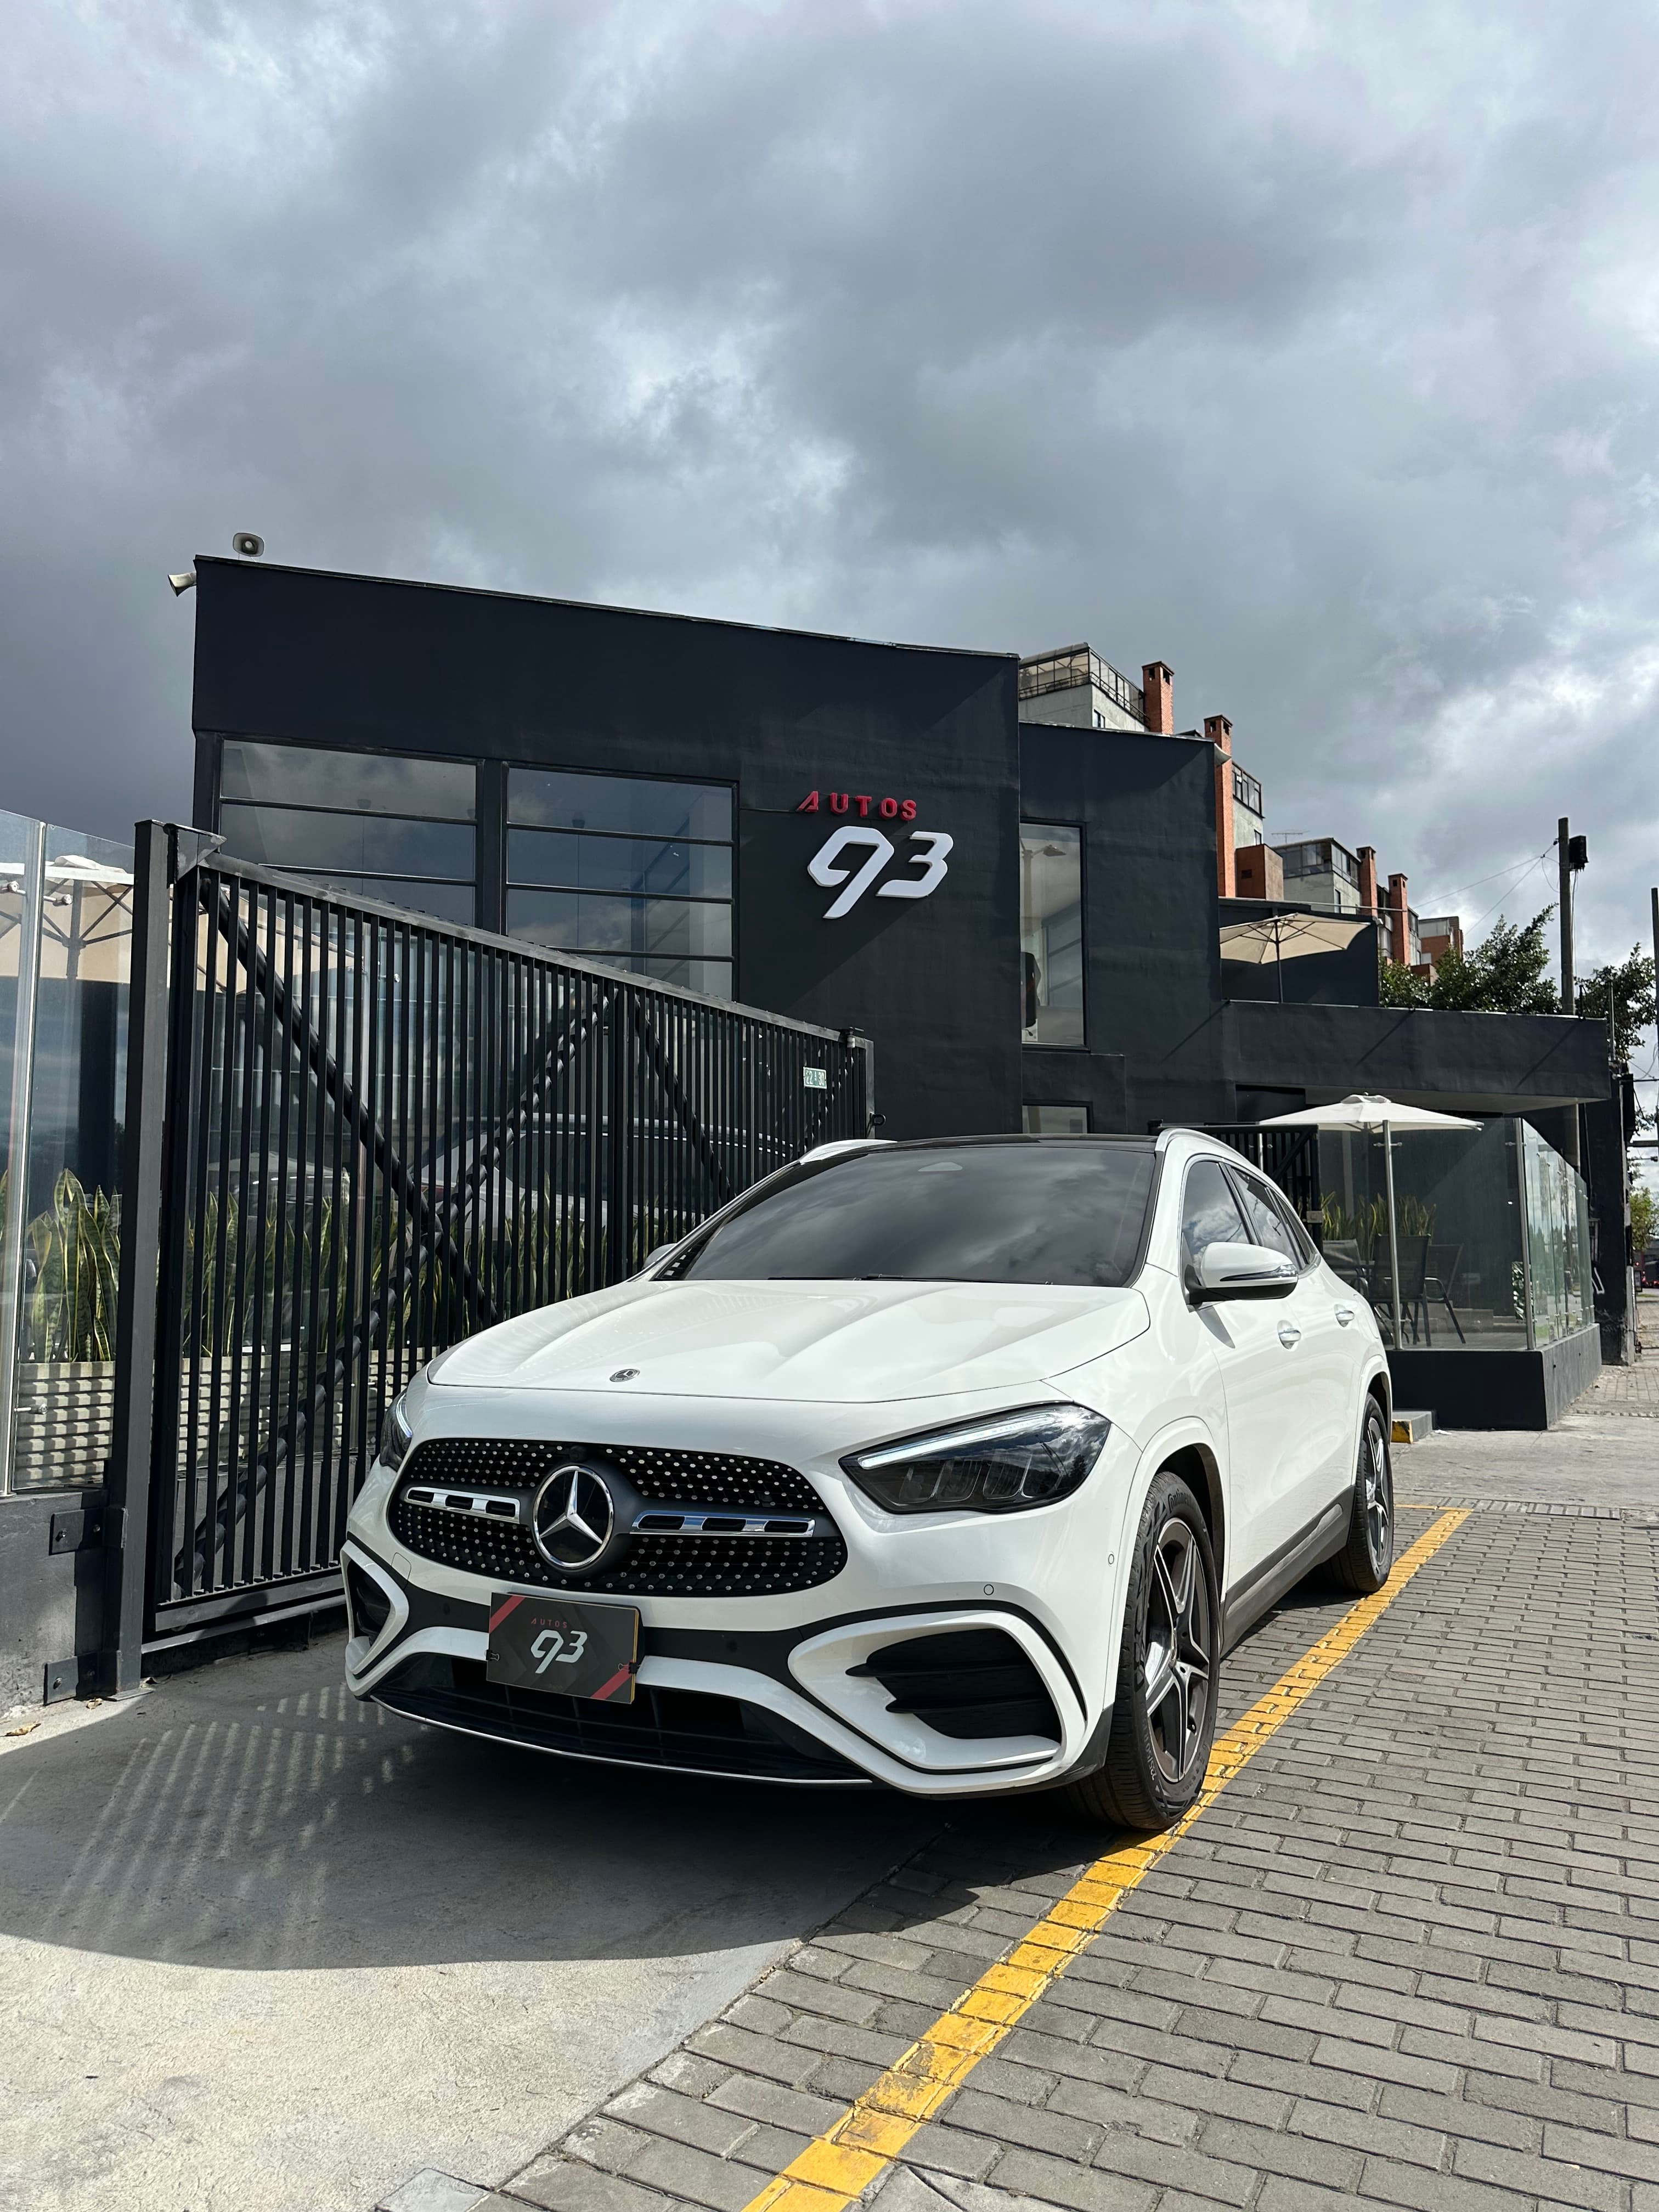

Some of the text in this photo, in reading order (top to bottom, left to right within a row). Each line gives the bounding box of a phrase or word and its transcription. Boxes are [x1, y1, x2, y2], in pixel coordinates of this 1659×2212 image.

[796, 791, 917, 821] AUTOS
[807, 826, 953, 919] 93
[806, 1070, 813, 1085] 22
[818, 1071, 825, 1086] 30
[531, 1618, 567, 1628] AUTOS
[531, 1629, 588, 1674] 93
